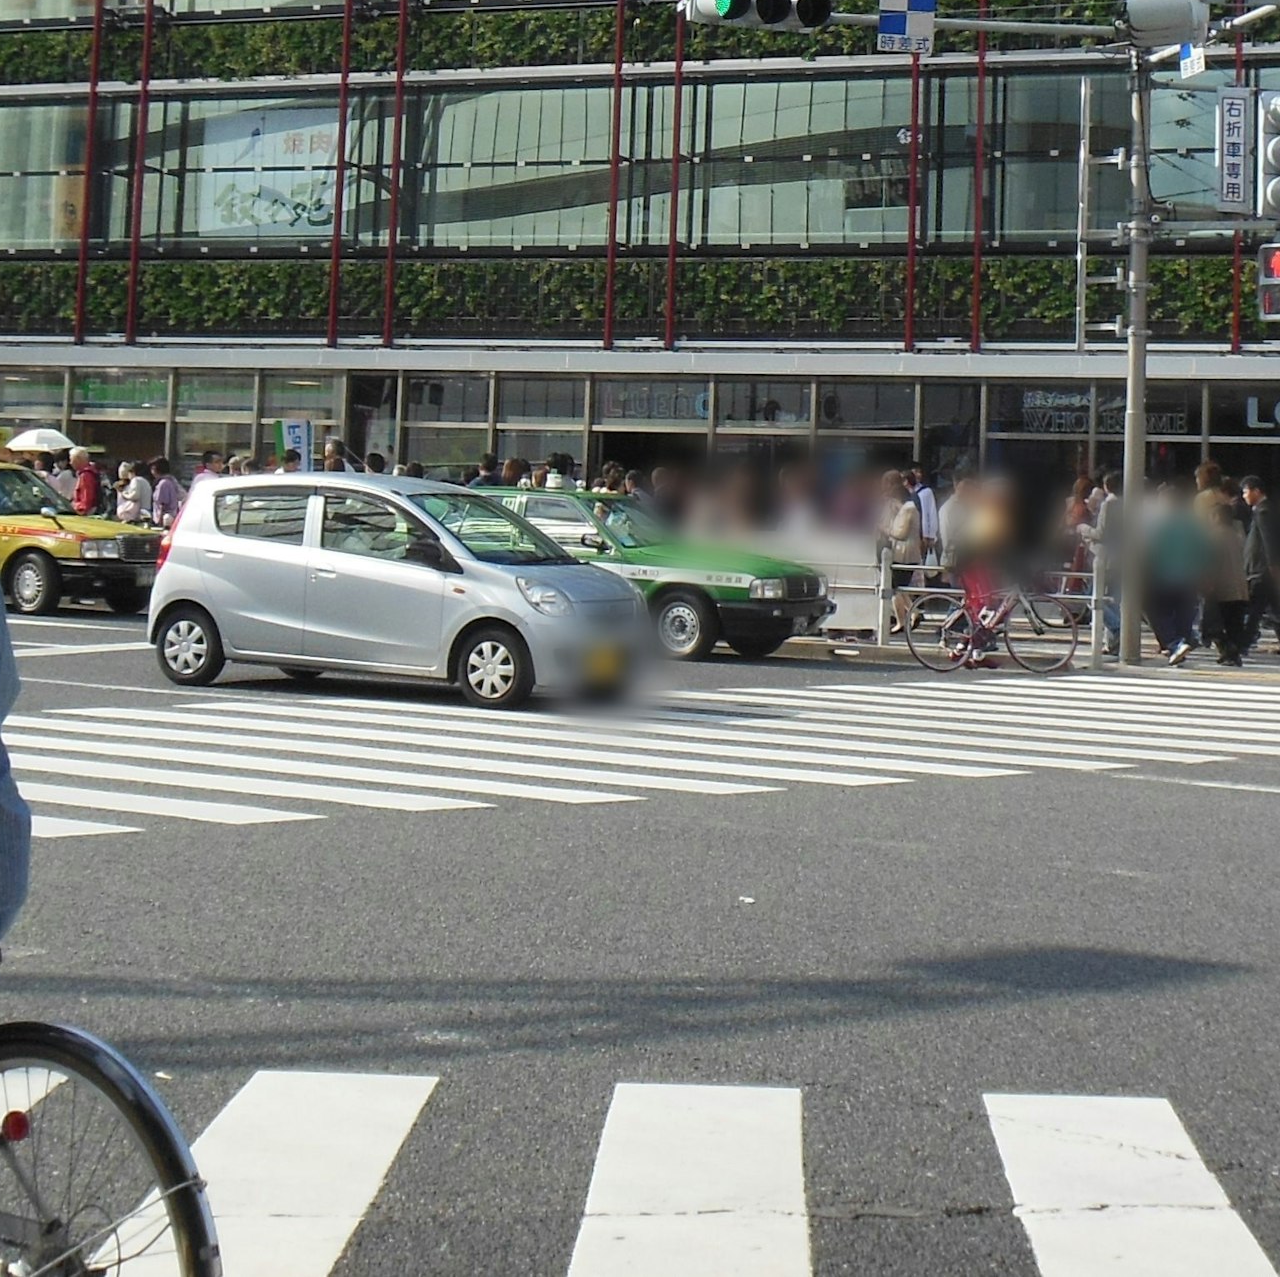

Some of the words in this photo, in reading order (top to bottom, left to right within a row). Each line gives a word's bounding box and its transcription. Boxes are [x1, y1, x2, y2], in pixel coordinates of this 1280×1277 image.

[879, 35, 930, 52] 時差式
[282, 132, 332, 155] 焼肉
[1225, 100, 1242, 200] 右折車専用
